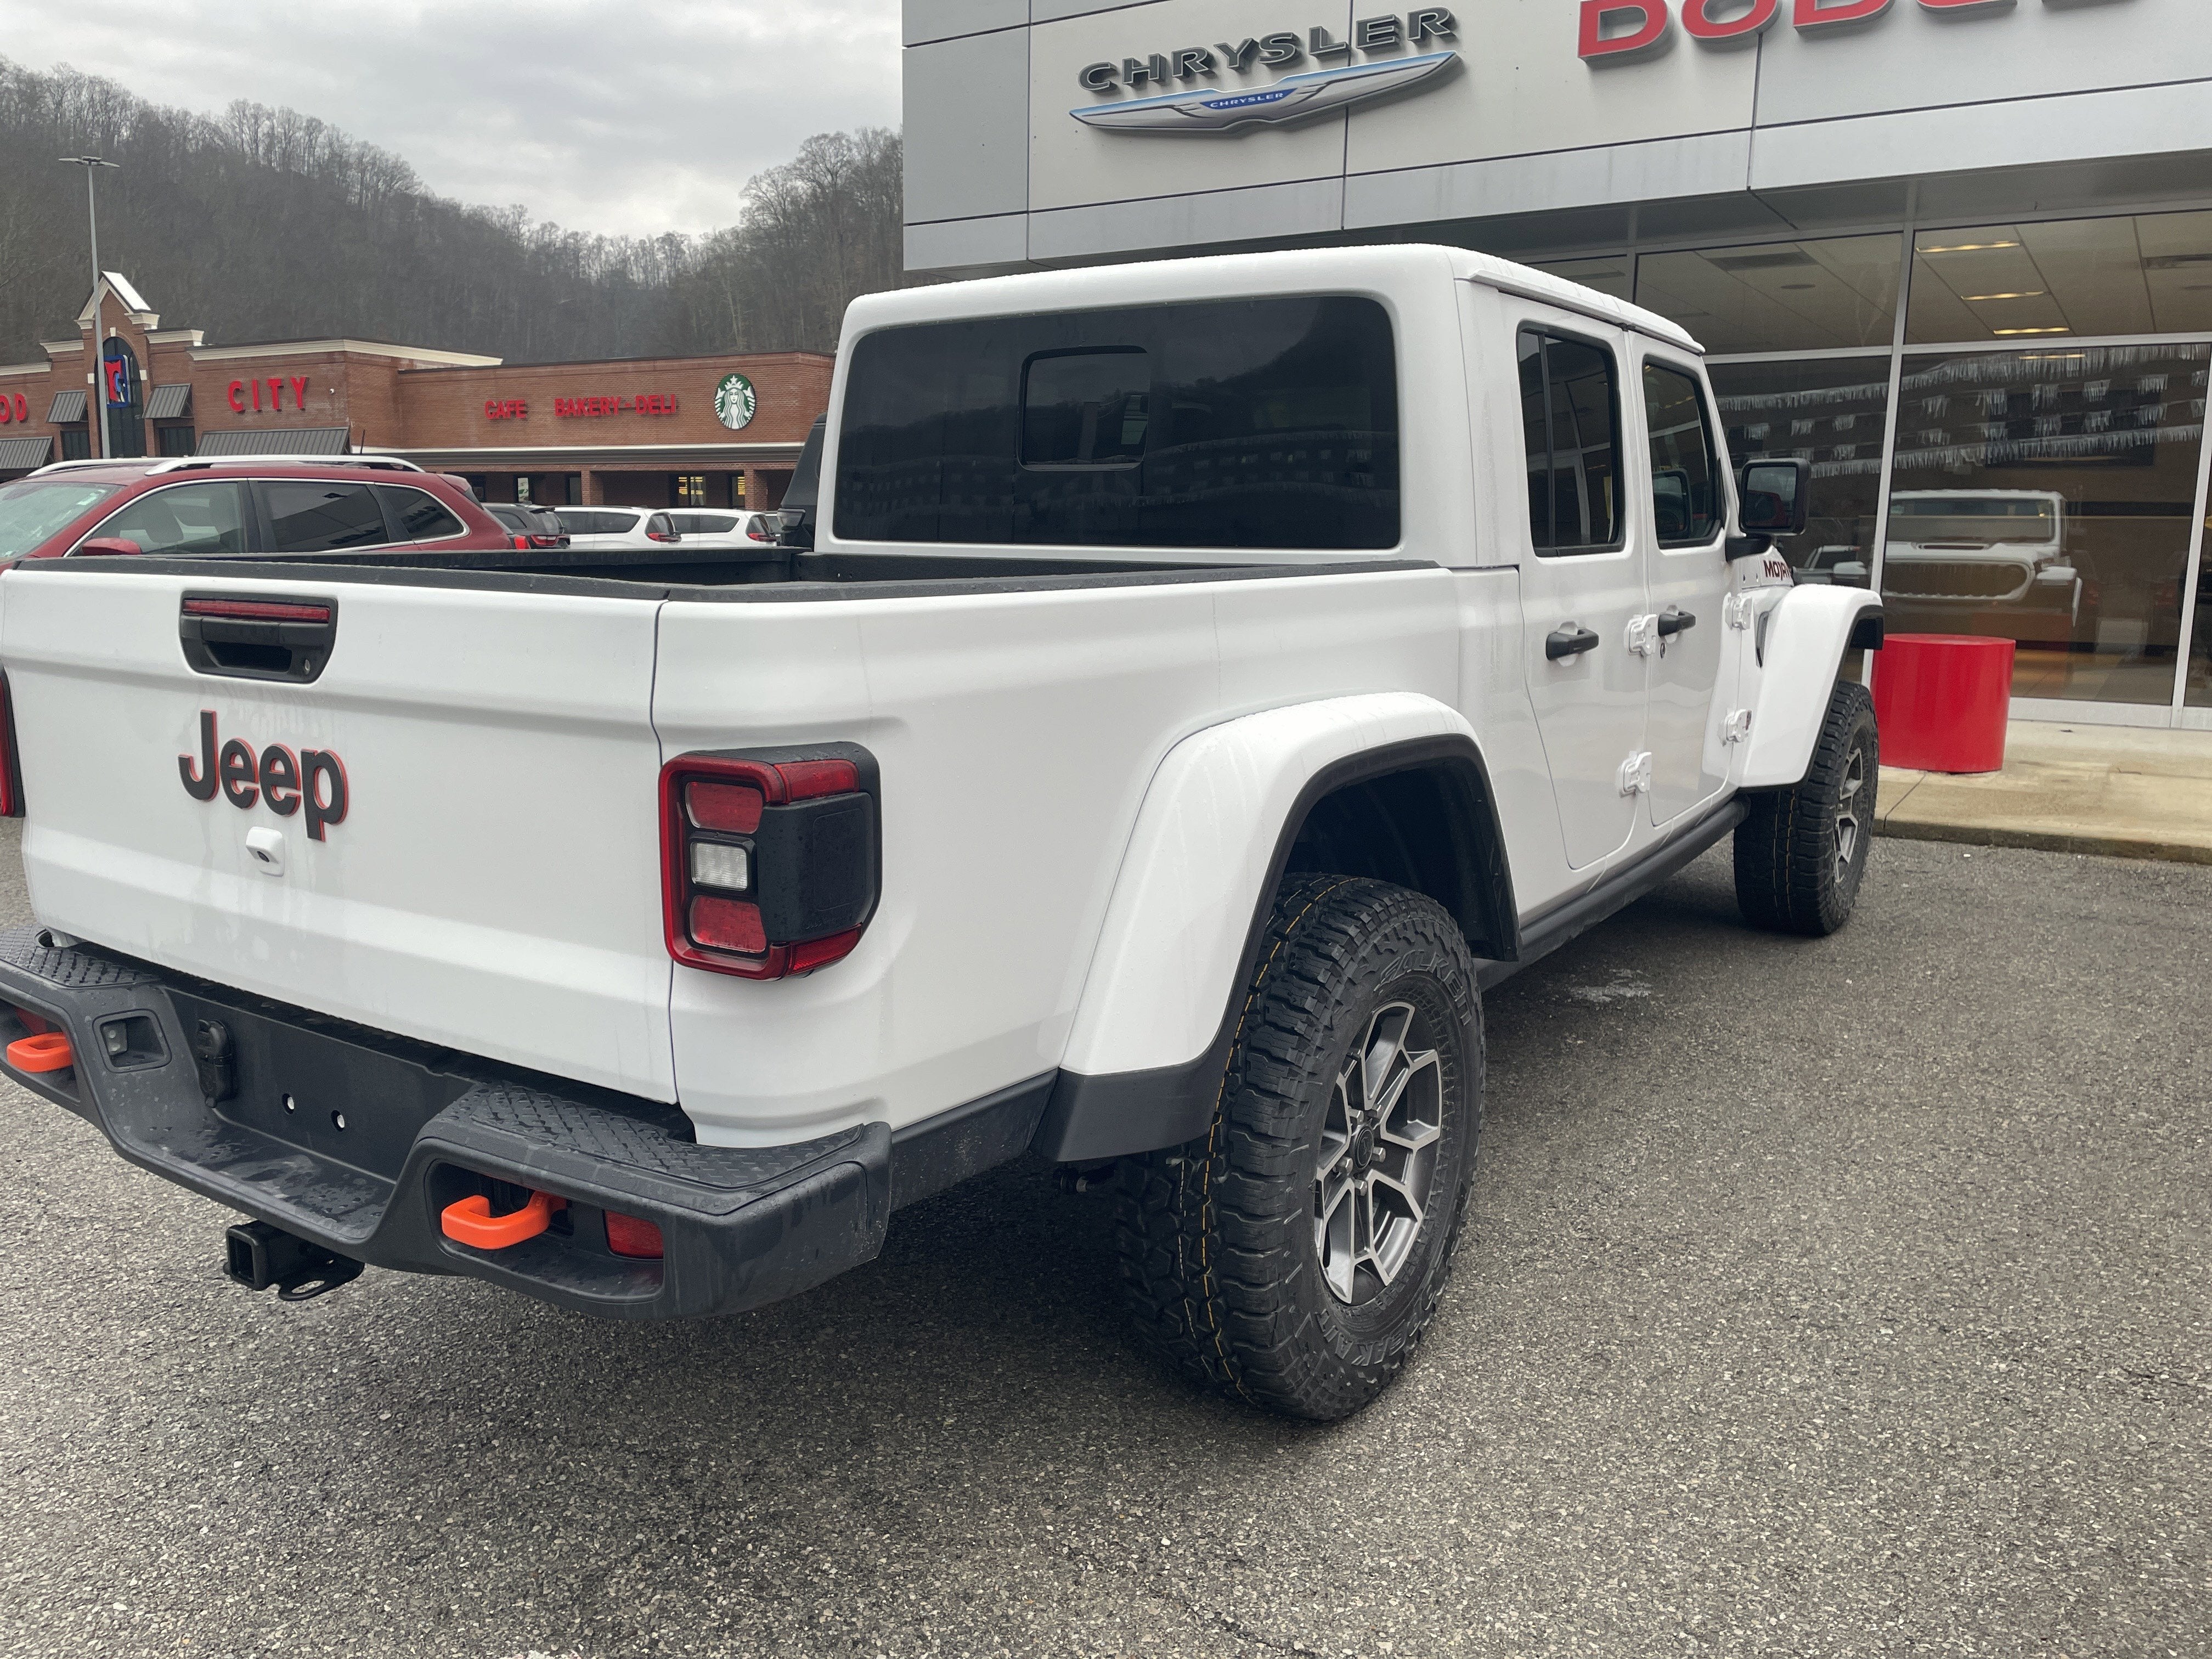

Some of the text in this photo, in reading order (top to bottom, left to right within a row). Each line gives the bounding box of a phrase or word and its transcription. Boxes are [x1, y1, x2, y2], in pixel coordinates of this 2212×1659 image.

[1077, 7, 1458, 91] CHRYSLER
[1210, 93, 1284, 108] CHRYSLER
[228, 376, 307, 413] CITY
[484, 399, 527, 420] CAFE
[178, 709, 349, 842] Jeep
